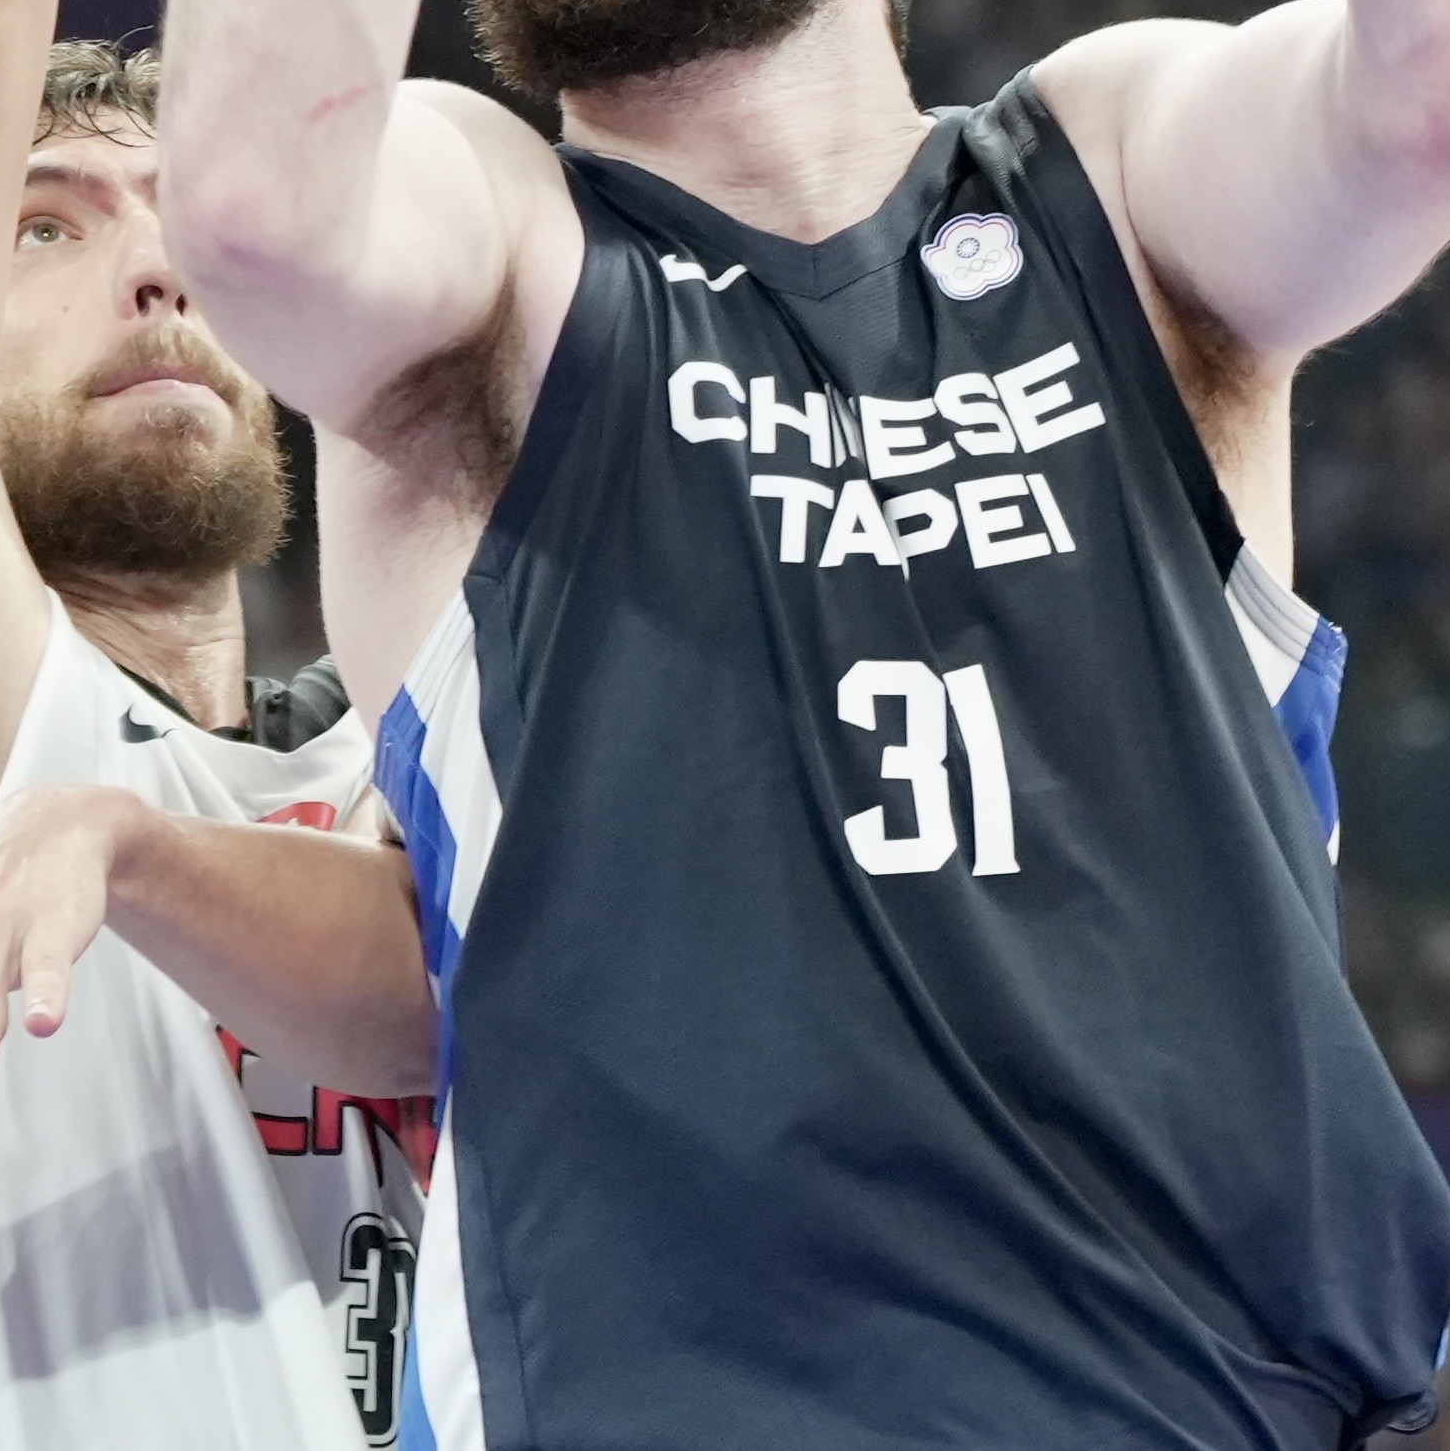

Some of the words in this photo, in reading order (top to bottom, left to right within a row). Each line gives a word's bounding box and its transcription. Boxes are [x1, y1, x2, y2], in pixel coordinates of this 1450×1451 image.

[667, 342, 1106, 480] CHESE
[749, 473, 1077, 581] TAPEI
[837, 660, 1021, 876] 31
